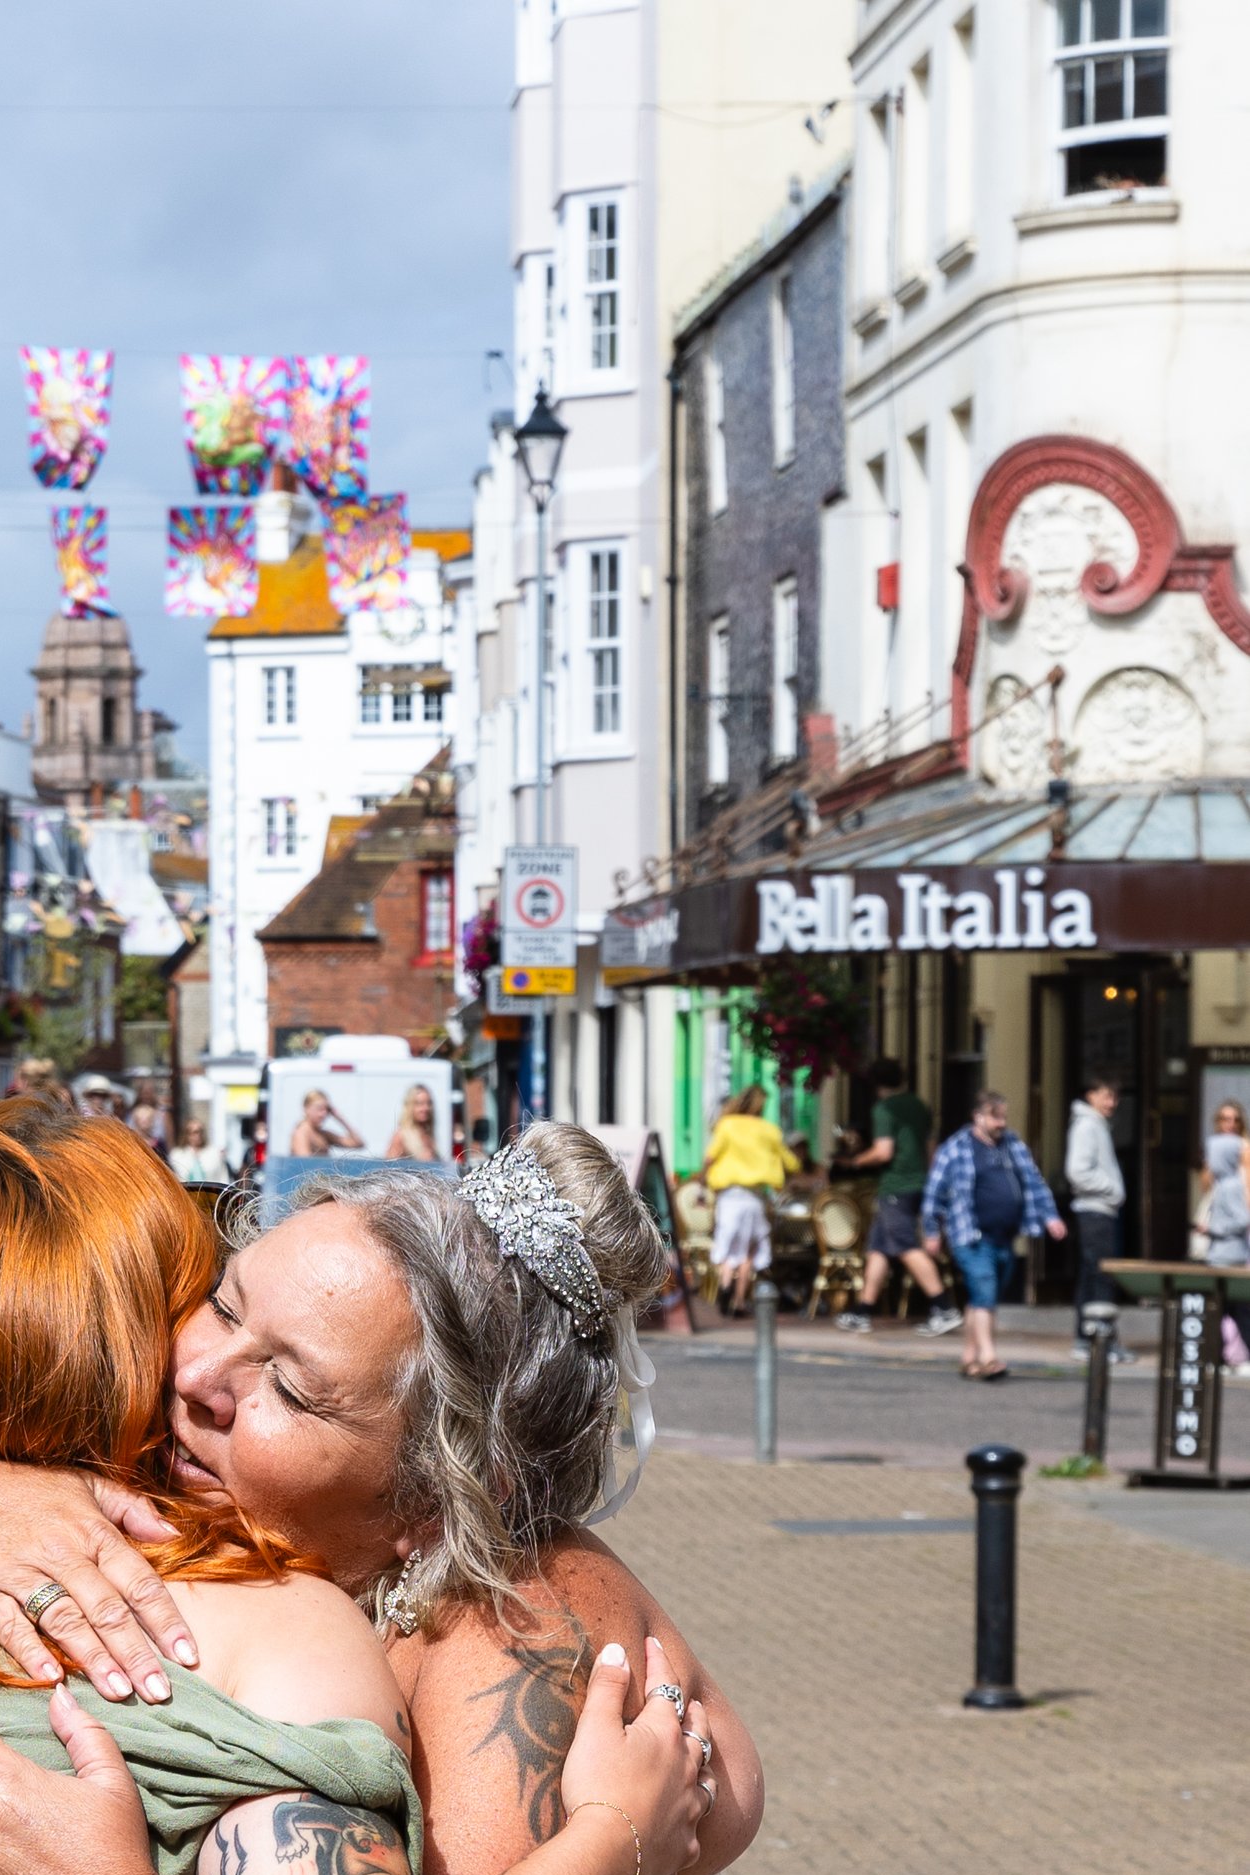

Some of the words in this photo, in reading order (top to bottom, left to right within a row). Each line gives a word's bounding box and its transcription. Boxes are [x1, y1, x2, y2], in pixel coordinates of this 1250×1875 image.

[518, 863, 563, 876] ZONE
[756, 873, 892, 954] Bella
[897, 867, 1097, 950] Italia
[1175, 1293, 1205, 1457] MOSHIMO
